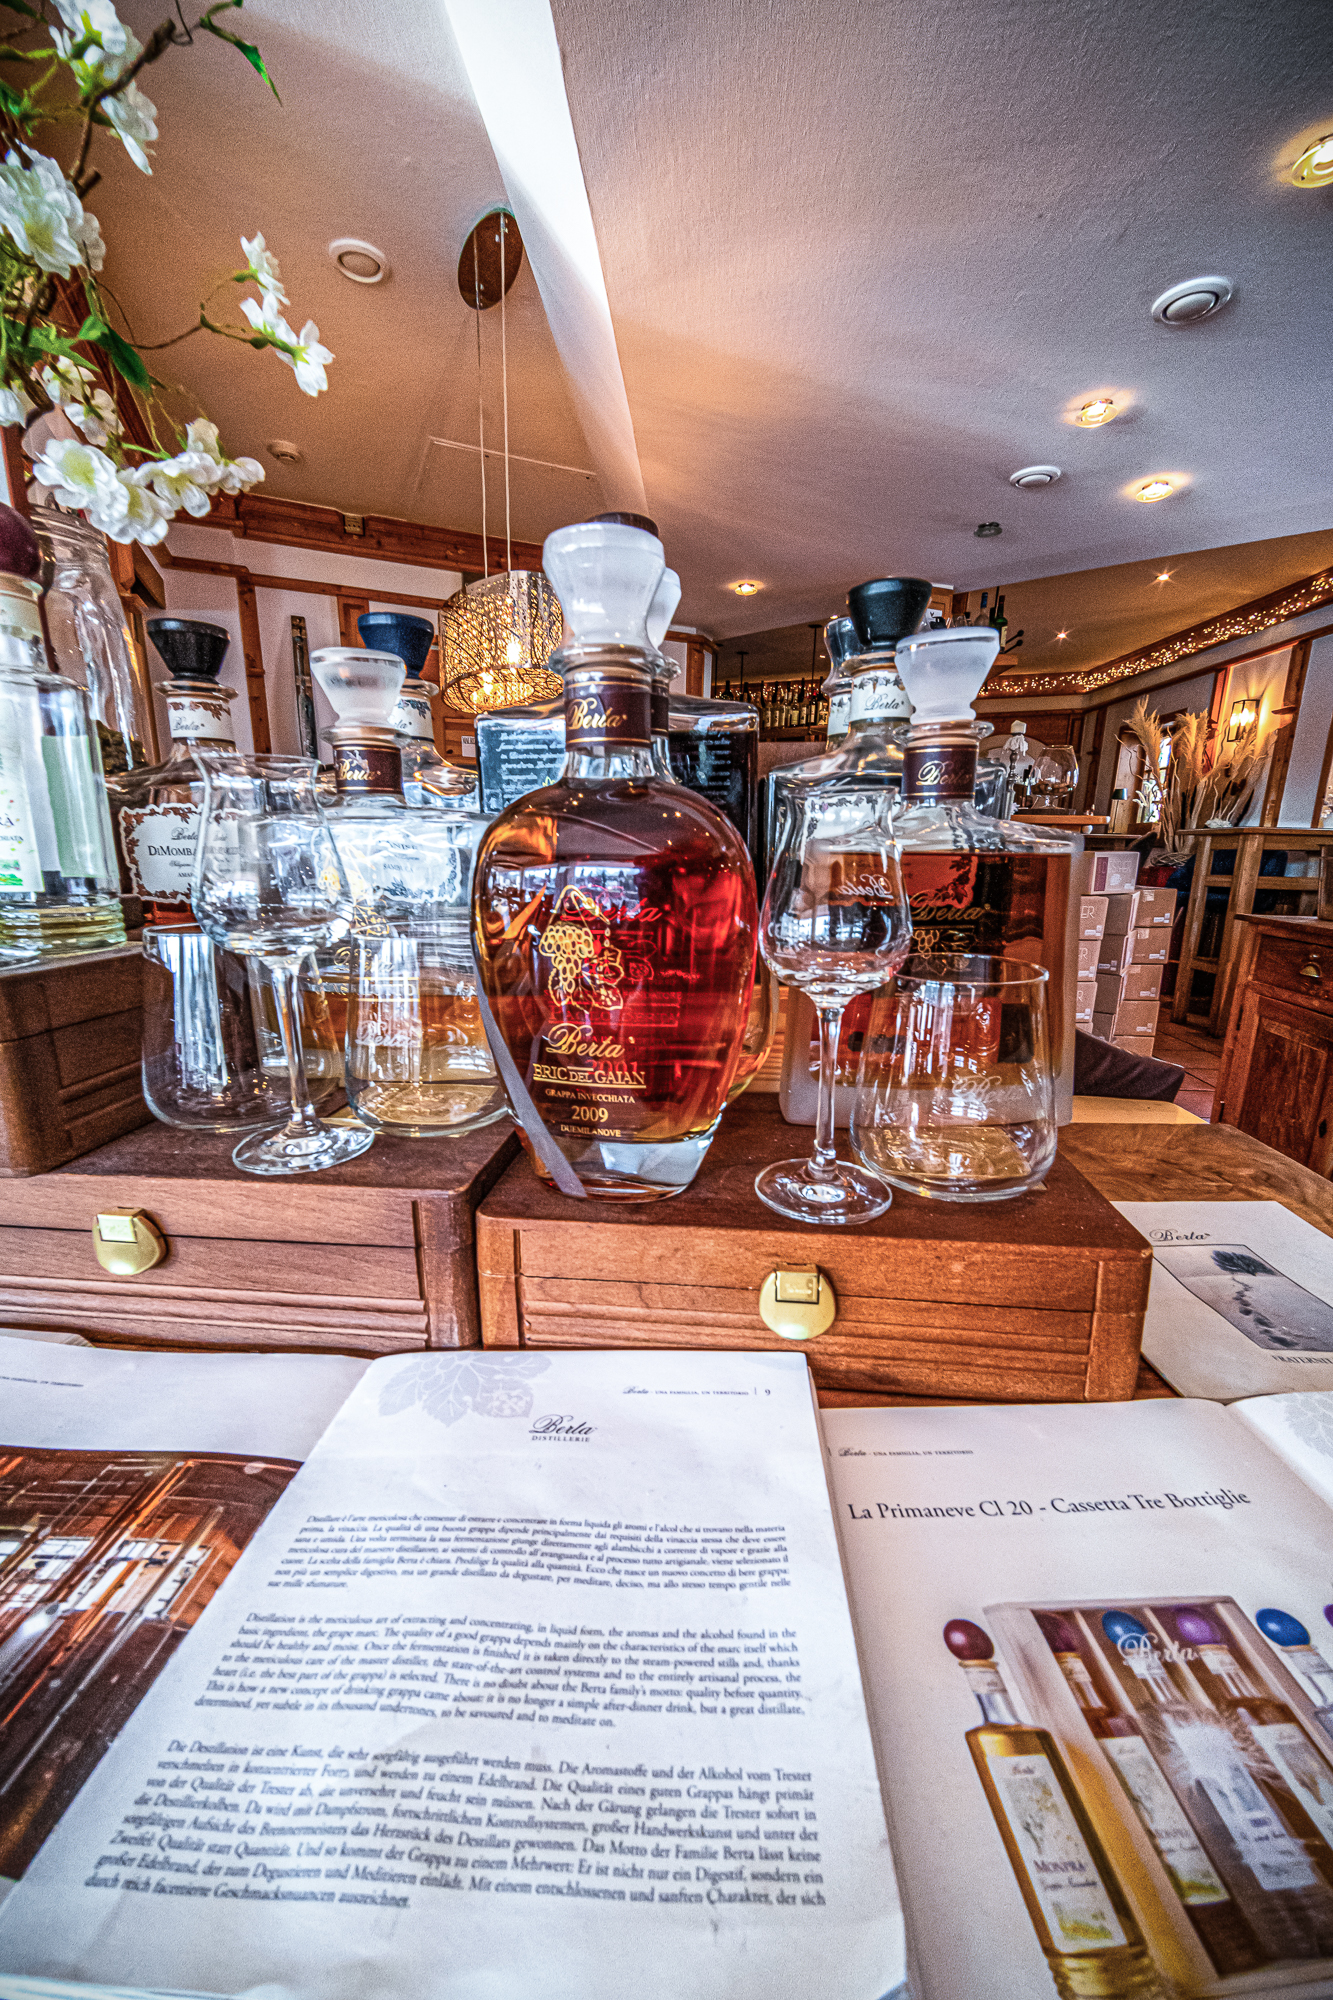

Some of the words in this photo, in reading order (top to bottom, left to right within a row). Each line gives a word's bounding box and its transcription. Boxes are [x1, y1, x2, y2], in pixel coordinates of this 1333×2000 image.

[864, 694, 900, 711] Berta
[567, 697, 622, 730] Berta
[172, 716, 199, 732] Berta
[546, 1023, 625, 1058] Berta
[533, 1063, 568, 1081] BRIC
[569, 1072, 593, 1083] DEL
[594, 1071, 646, 1085] GAIAN
[545, 1088, 577, 1100] GRAPPA
[577, 1092, 636, 1104] INVECCHIATA
[571, 1105, 609, 1123] 2009
[560, 1124, 622, 1138] DUEMILANOVE
[1149, 1229, 1206, 1242] Berta
[528, 1414, 595, 1435] Berta
[531, 1434, 591, 1443] DISTILLERIE
[847, 1503, 873, 1520] La
[876, 1502, 976, 1520] Primaneve
[1006, 1500, 1033, 1516] 20
[1050, 1497, 1131, 1514] Cassetta
[1127, 1493, 1166, 1510] Tre
[1164, 1487, 1251, 1510] Bottiglie
[449, 1615, 467, 1626] and
[549, 1624, 578, 1637] liquid
[662, 1629, 680, 1639] and
[682, 1629, 697, 1639] the
[700, 1629, 734, 1640] alcohol
[737, 1629, 766, 1640] found
[781, 1628, 797, 1638] the
[554, 1639, 585, 1650] mainly
[620, 1641, 685, 1653] characteristics
[769, 1642, 799, 1652] which
[1117, 1632, 1200, 1665] Berta
[572, 1653, 608, 1666] directly
[642, 1657, 715, 1670] steam-powered
[718, 1658, 739, 1668] stills
[767, 1657, 800, 1668] thanks
[525, 1666, 560, 1676] control
[564, 1670, 600, 1678] systems
[657, 1671, 694, 1682] entirely
[698, 1672, 739, 1683] artisanal
[785, 1672, 801, 1683] the
[531, 1679, 559, 1691] about
[562, 1680, 577, 1692] the
[581, 1682, 607, 1694] Berta
[609, 1683, 647, 1696] family's
[723, 1687, 754, 1698] before
[567, 1698, 599, 1713] simple
[603, 1699, 663, 1713] after-dinner
[700, 1702, 718, 1714] but
[729, 1706, 754, 1718] great
[516, 1710, 536, 1722] and
[551, 1713, 596, 1727] meditate
